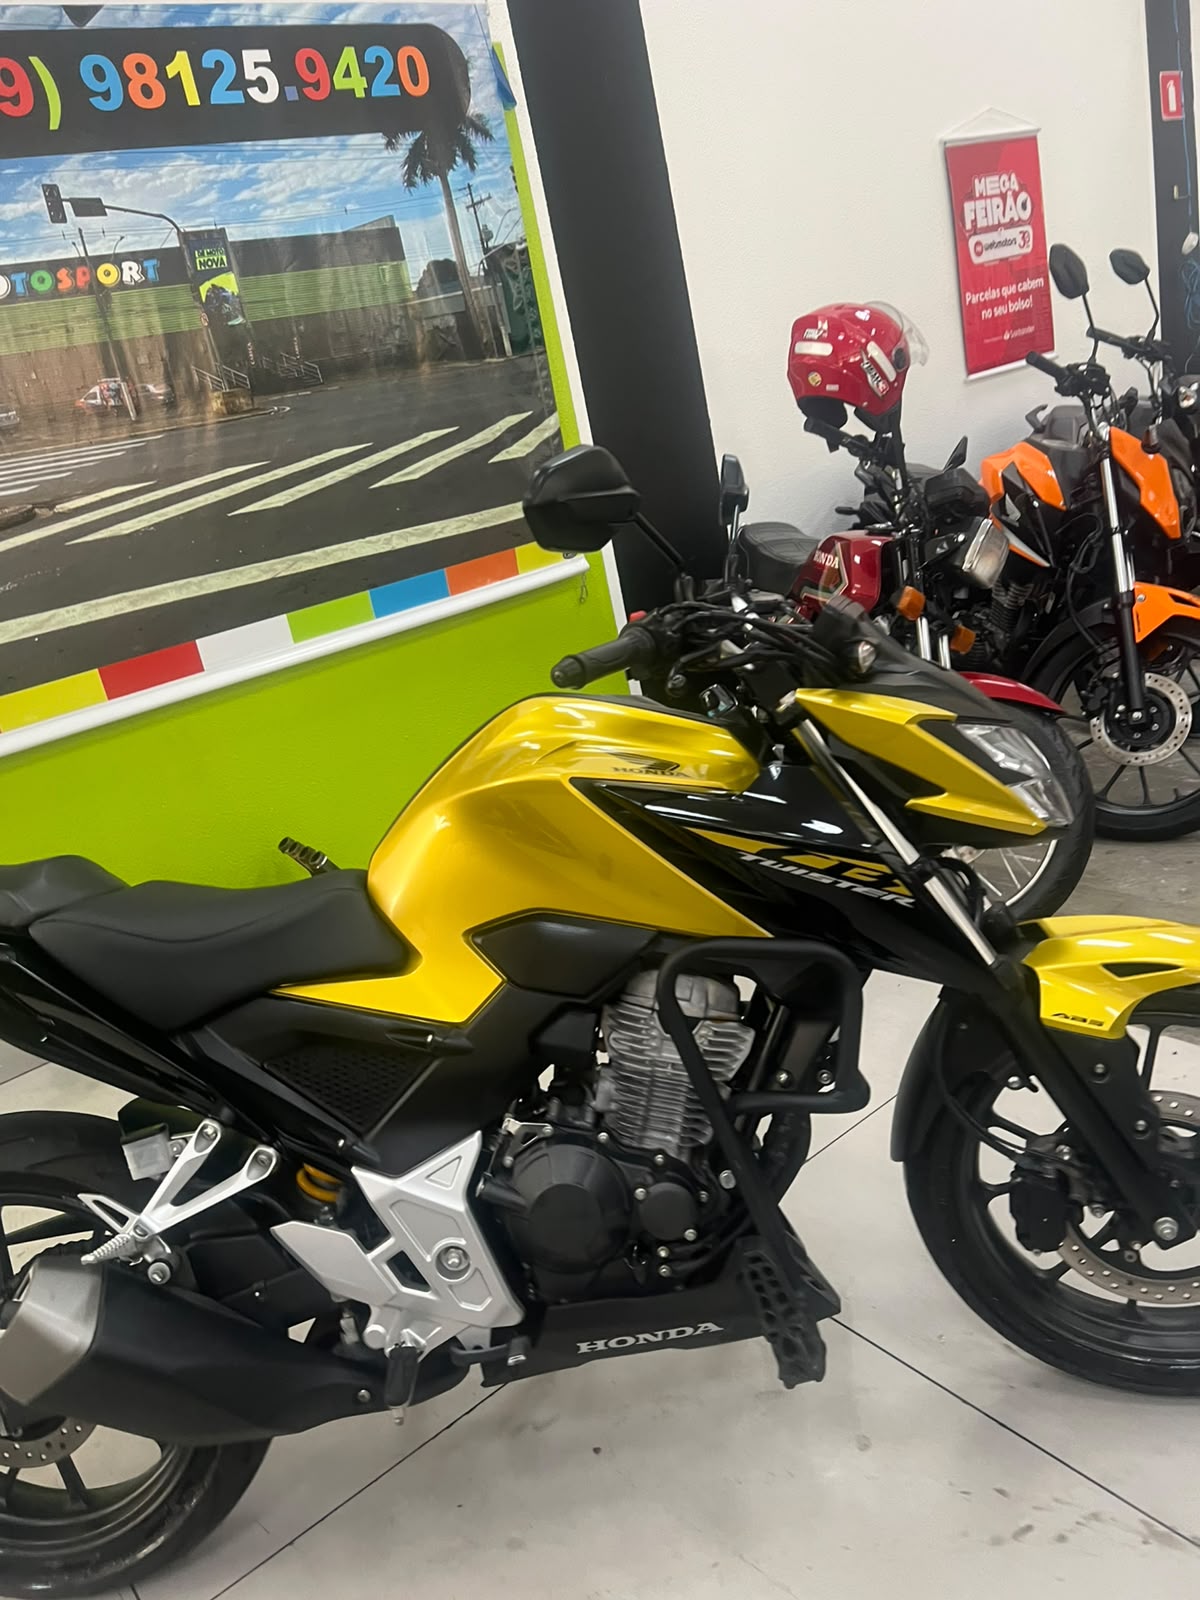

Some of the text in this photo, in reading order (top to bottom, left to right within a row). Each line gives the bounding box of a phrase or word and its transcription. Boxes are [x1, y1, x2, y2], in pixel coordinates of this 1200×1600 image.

[0, 45, 430, 131] 9) 98125.9420
[974, 172, 1019, 198] MEGA
[963, 190, 1032, 231] FEIRÃO
[198, 256, 226, 269] NOVA
[965, 277, 1045, 306] Parcelas que cabem
[981, 294, 1033, 320] no seu bolso!
[612, 766, 692, 779] HONDA
[737, 851, 916, 909] TWISTER
[1050, 1012, 1105, 1027] ABS
[576, 1322, 724, 1354] HONDA
